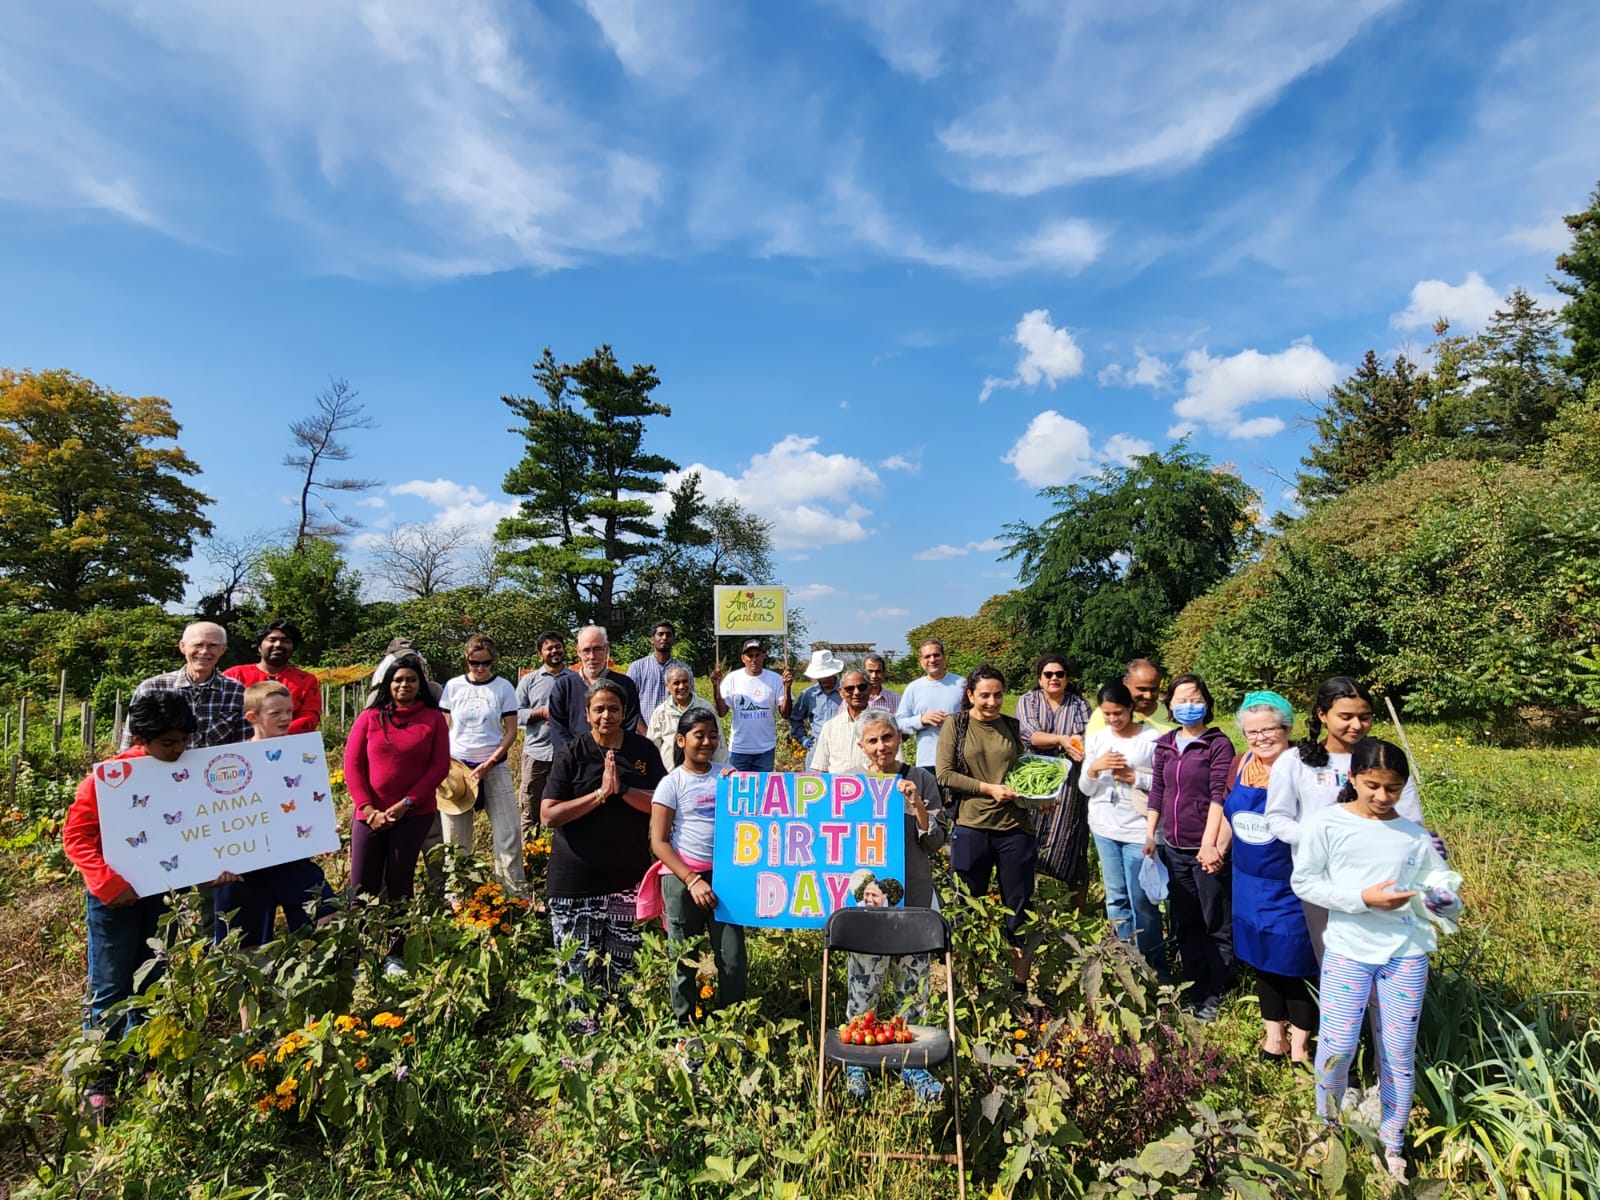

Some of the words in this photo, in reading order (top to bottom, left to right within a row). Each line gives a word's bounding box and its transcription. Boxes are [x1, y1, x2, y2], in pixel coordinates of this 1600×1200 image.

[726, 610, 775, 629] Gardens
[196, 792, 263, 817] AMMA
[728, 772, 897, 818] HAPPY
[181, 823, 212, 843] WE
[222, 811, 271, 833] LOVE
[213, 839, 257, 860] YOU
[733, 821, 888, 867] BIRTH
[756, 871, 852, 917] DAY
